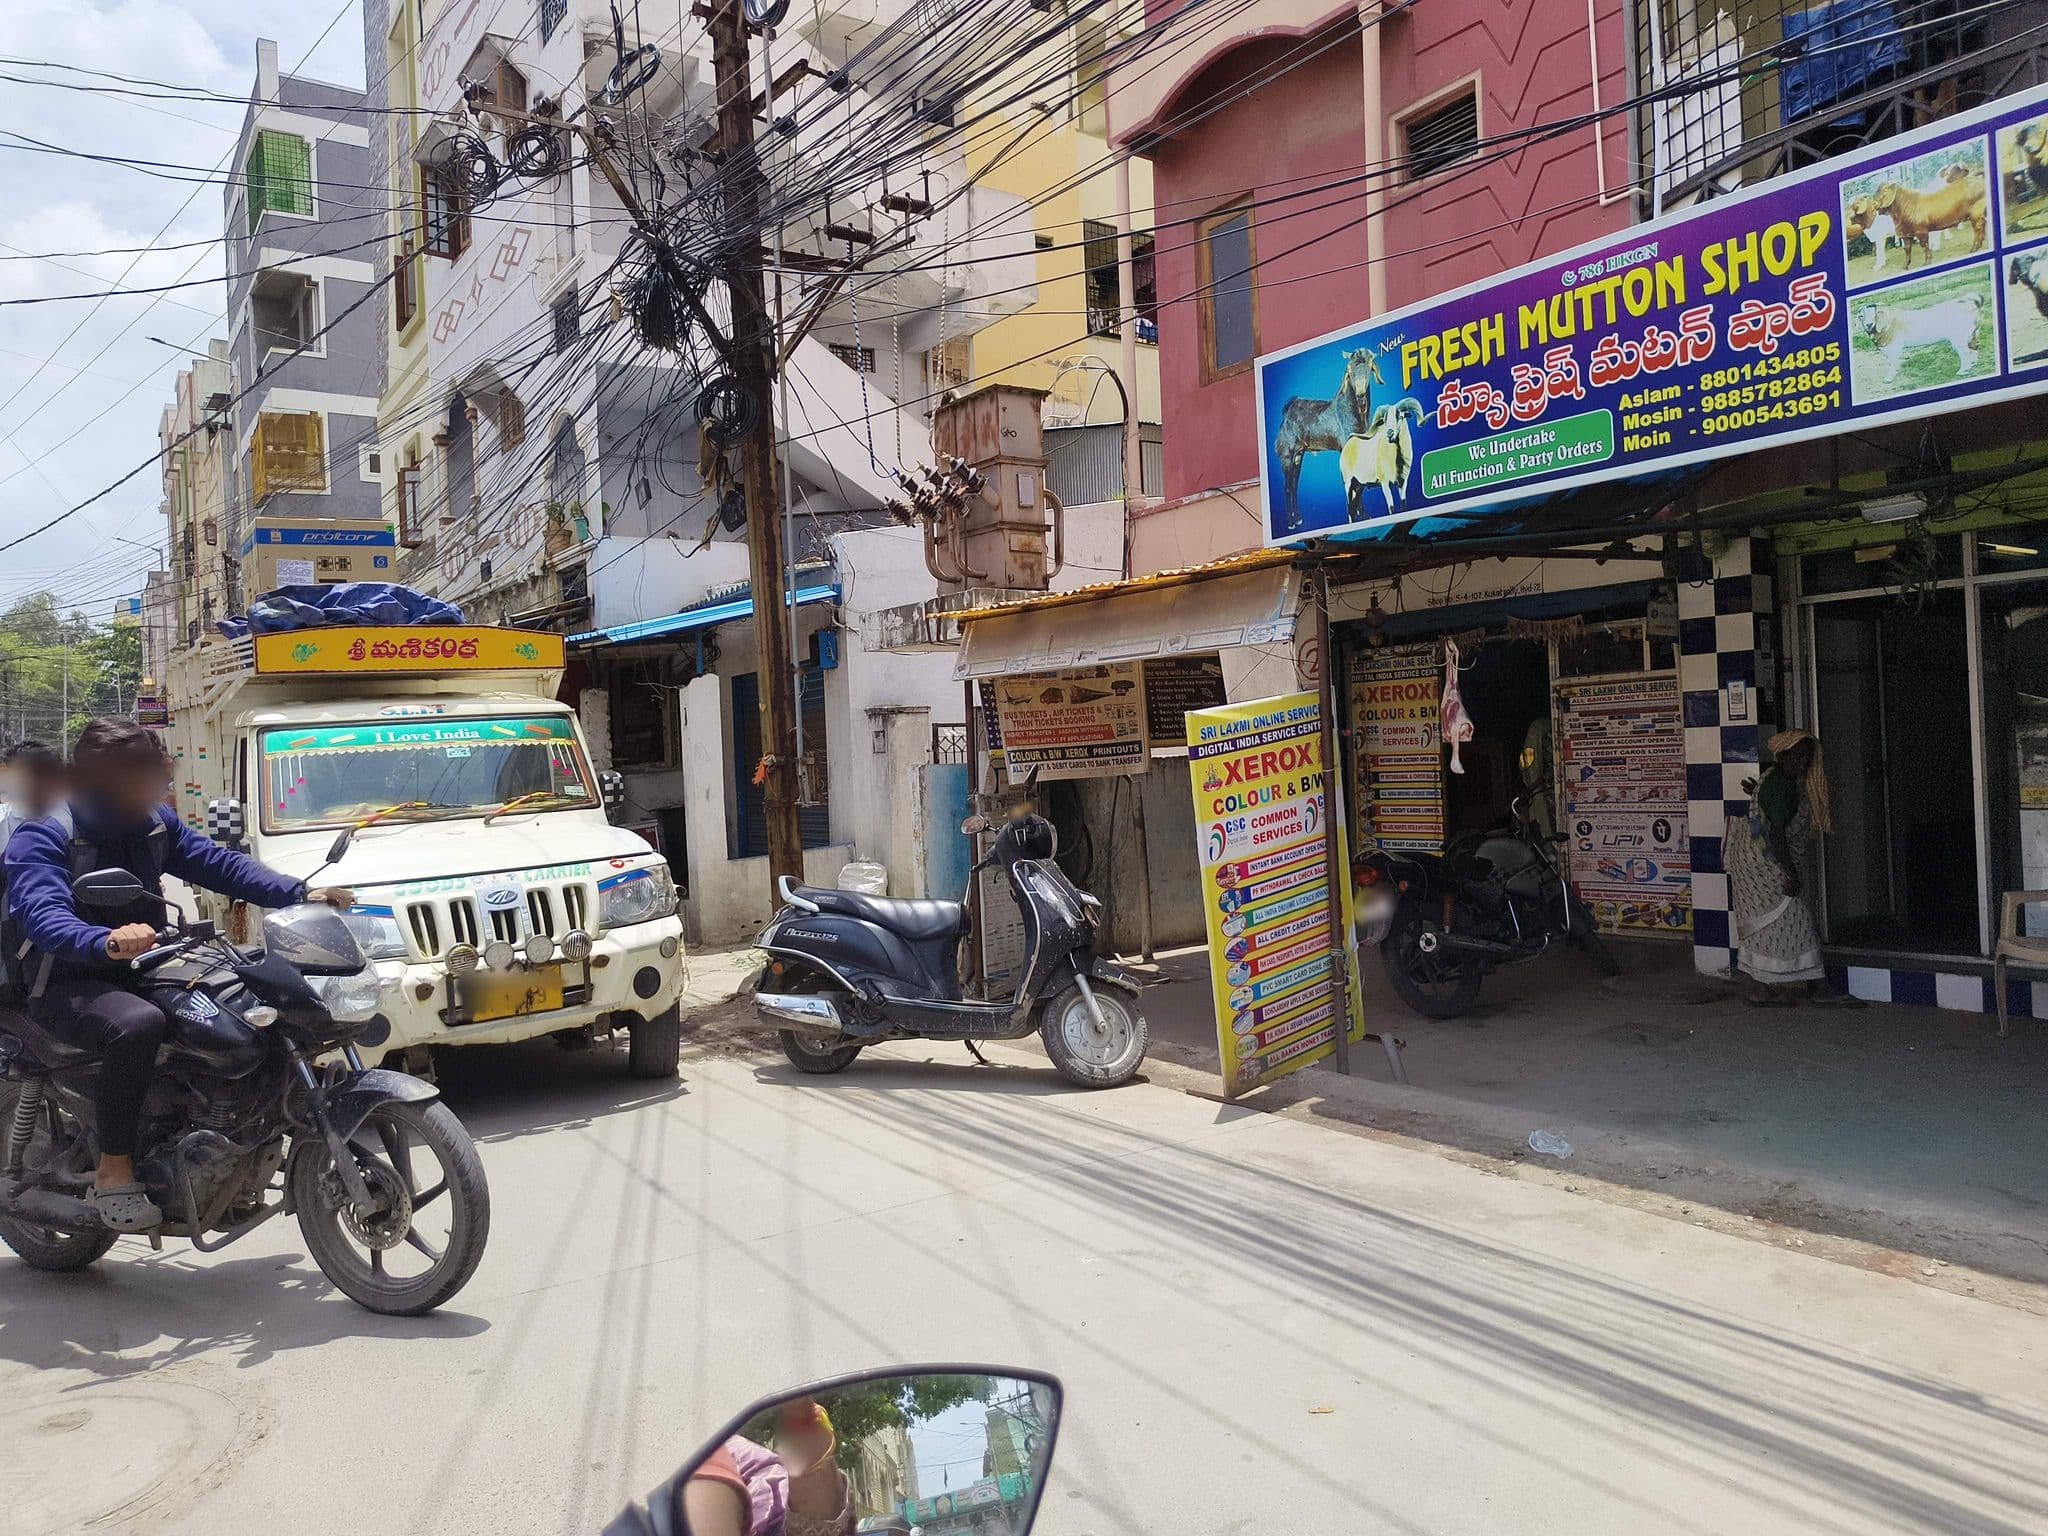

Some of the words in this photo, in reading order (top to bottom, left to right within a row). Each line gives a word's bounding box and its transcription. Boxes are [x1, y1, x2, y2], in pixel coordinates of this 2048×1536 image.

[1578, 261, 1603, 282] 786
[1606, 243, 1659, 273] HKGN
[1401, 313, 1505, 390] FRESH
[1518, 255, 1686, 349] MUTTON
[1701, 211, 1831, 296] SHOP
[1377, 333, 1406, 357] New
[1437, 378, 1509, 429] న్యూ
[1589, 304, 1716, 387] మటన్
[1728, 272, 1835, 354] షాప్
[1619, 385, 1681, 411] Aslam
[1700, 342, 1840, 391] 8801434805
[1623, 405, 1682, 431] Mosin
[1701, 366, 1842, 413] 9885782864
[1624, 430, 1670, 452] Moin
[1702, 390, 1840, 435] 9000543691
[1469, 446, 1487, 461] We
[1489, 428, 1556, 457] Undertake
[1431, 476, 1446, 489] All
[1450, 465, 1503, 484] Function
[1506, 458, 1516, 471] &
[1520, 451, 1554, 470] Party
[1557, 439, 1602, 460] Orders
[348, 638, 366, 661] శ్రీ
[1394, 669, 1420, 679] SERVICE
[1366, 683, 1431, 704] XEROX
[1592, 685, 1616, 695] LAXMI
[1618, 683, 1646, 692] ONLINE
[1003, 711, 1018, 720] BUS
[1018, 709, 1047, 719] TICKETS
[1053, 708, 1064, 717] AIR
[1065, 707, 1095, 716] TICKETS
[1012, 719, 1033, 728] TRAIN
[1034, 717, 1063, 727] TICKETS
[1064, 715, 1096, 725] BOOKING
[1200, 726, 1217, 740] SRI
[1219, 720, 1251, 739] LAXMI
[1253, 712, 1286, 729] ONLINE
[1287, 704, 1320, 720] SERVIC
[1358, 708, 1405, 721] COLOUR
[1409, 708, 1416, 718] &
[375, 732, 383, 743] I
[388, 732, 431, 742] Love
[434, 728, 480, 741] India
[1198, 741, 1235, 757] DIGITAL
[1236, 736, 1261, 749] INDIA
[1262, 727, 1297, 743] SERVICE
[1382, 727, 1416, 735] COMMON
[1382, 738, 1419, 746] SERVICES
[1010, 751, 1041, 762] COLOUR
[1048, 750, 1062, 760] B/W
[1065, 748, 1089, 758] XEROX
[1092, 744, 1139, 756] PRINTOUTS
[1012, 765, 1024, 773] ALL
[1052, 761, 1068, 770] DEBIT
[1068, 760, 1086, 768] CARDS
[1087, 759, 1095, 767] TO
[1096, 758, 1112, 767] BANK
[1112, 755, 1142, 765] TRANSFER
[1222, 742, 1313, 787] XEROX
[1212, 784, 1282, 816] COLOUR
[1287, 782, 1297, 796] &
[1226, 817, 1246, 833] CSC
[1251, 807, 1298, 829] COMMON
[1253, 821, 1303, 845] SERVICES
[1602, 835, 1636, 846] UPI
[1250, 859, 1270, 872] INSTANT
[1271, 855, 1284, 866] BANK
[1284, 848, 1304, 861] ACCOUNT
[1305, 845, 1317, 854] OPEN
[523, 862, 592, 882] CARRIER
[1298, 870, 1313, 880] CHECK
[1255, 911, 1264, 920] ALL
[1257, 934, 1269, 945] ALL
[1270, 926, 1291, 940] CREDIT
[1292, 919, 1310, 931] CARDS
[1311, 911, 1330, 924] LOWES
[1262, 982, 1274, 993] PVC
[1274, 974, 1293, 988] SMART
[1293, 968, 1308, 981] CARD
[1308, 963, 1322, 974] DONE
[176, 1008, 214, 1026] HOND
[1264, 999, 1290, 1016] SCHOLARSHIP
[1269, 1055, 1280, 1065] ALL
[1280, 1046, 1300, 1060] BANKS
[1300, 1036, 1319, 1050] MONEY
